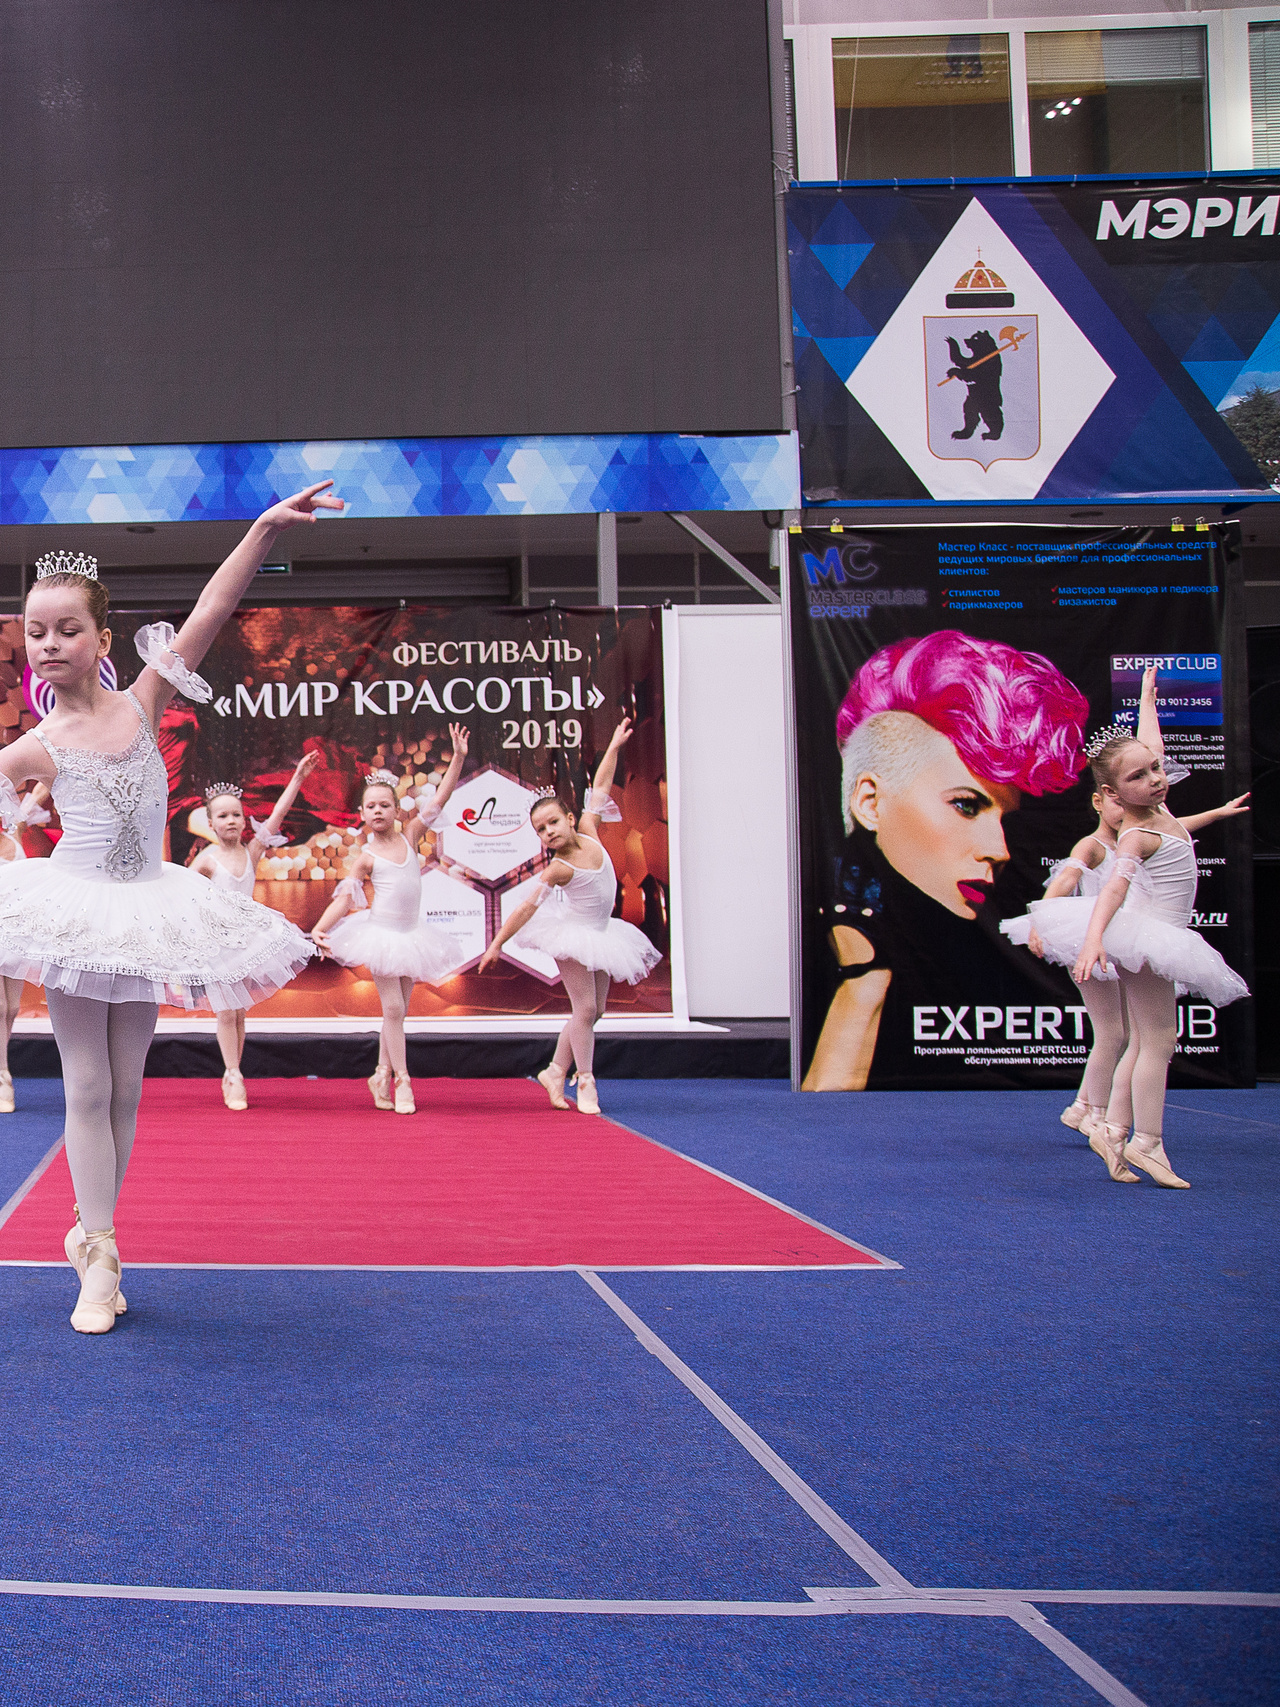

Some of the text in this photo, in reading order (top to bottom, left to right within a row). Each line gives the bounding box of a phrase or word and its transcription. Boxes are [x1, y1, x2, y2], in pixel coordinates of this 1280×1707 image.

[1096, 195, 1280, 240] МЭРИ
[938, 542, 976, 553] Мастер
[979, 542, 1008, 551] Класс
[1016, 543, 1072, 552] поставщик
[1074, 541, 1173, 552] профессиональных
[1176, 541, 1217, 551] средств
[939, 553, 1202, 565] ведущих мировых брендов для профессиональных
[939, 568, 990, 576] клиентов:
[949, 589, 1000, 597] стилистов
[1058, 586, 1106, 595] мастеров
[1108, 586, 1158, 595] маникюра
[1170, 585, 1219, 594] педикюра
[949, 601, 1023, 611] парикмахеров
[1059, 598, 1117, 606] визажистов
[393, 639, 583, 667] ФЕСТИВАЛЬ
[1112, 656, 1217, 670] EXPERTCLUB
[213, 676, 606, 719] «МИР КРАСОТЫ»
[1155, 698, 1167, 706] 78
[1167, 698, 1189, 706] 9012
[1190, 698, 1213, 706] 3456
[1115, 711, 1135, 723] MC
[502, 719, 583, 749] 2019
[1160, 734, 1202, 742] ERTCLUB
[1196, 857, 1226, 865] овиях
[914, 1045, 965, 1056] Программа
[967, 1047, 1021, 1055] лояльности
[1023, 1045, 1086, 1054] EXPERTCLUB
[1184, 1045, 1220, 1056] формат
[964, 1056, 1031, 1066] обслуживания
